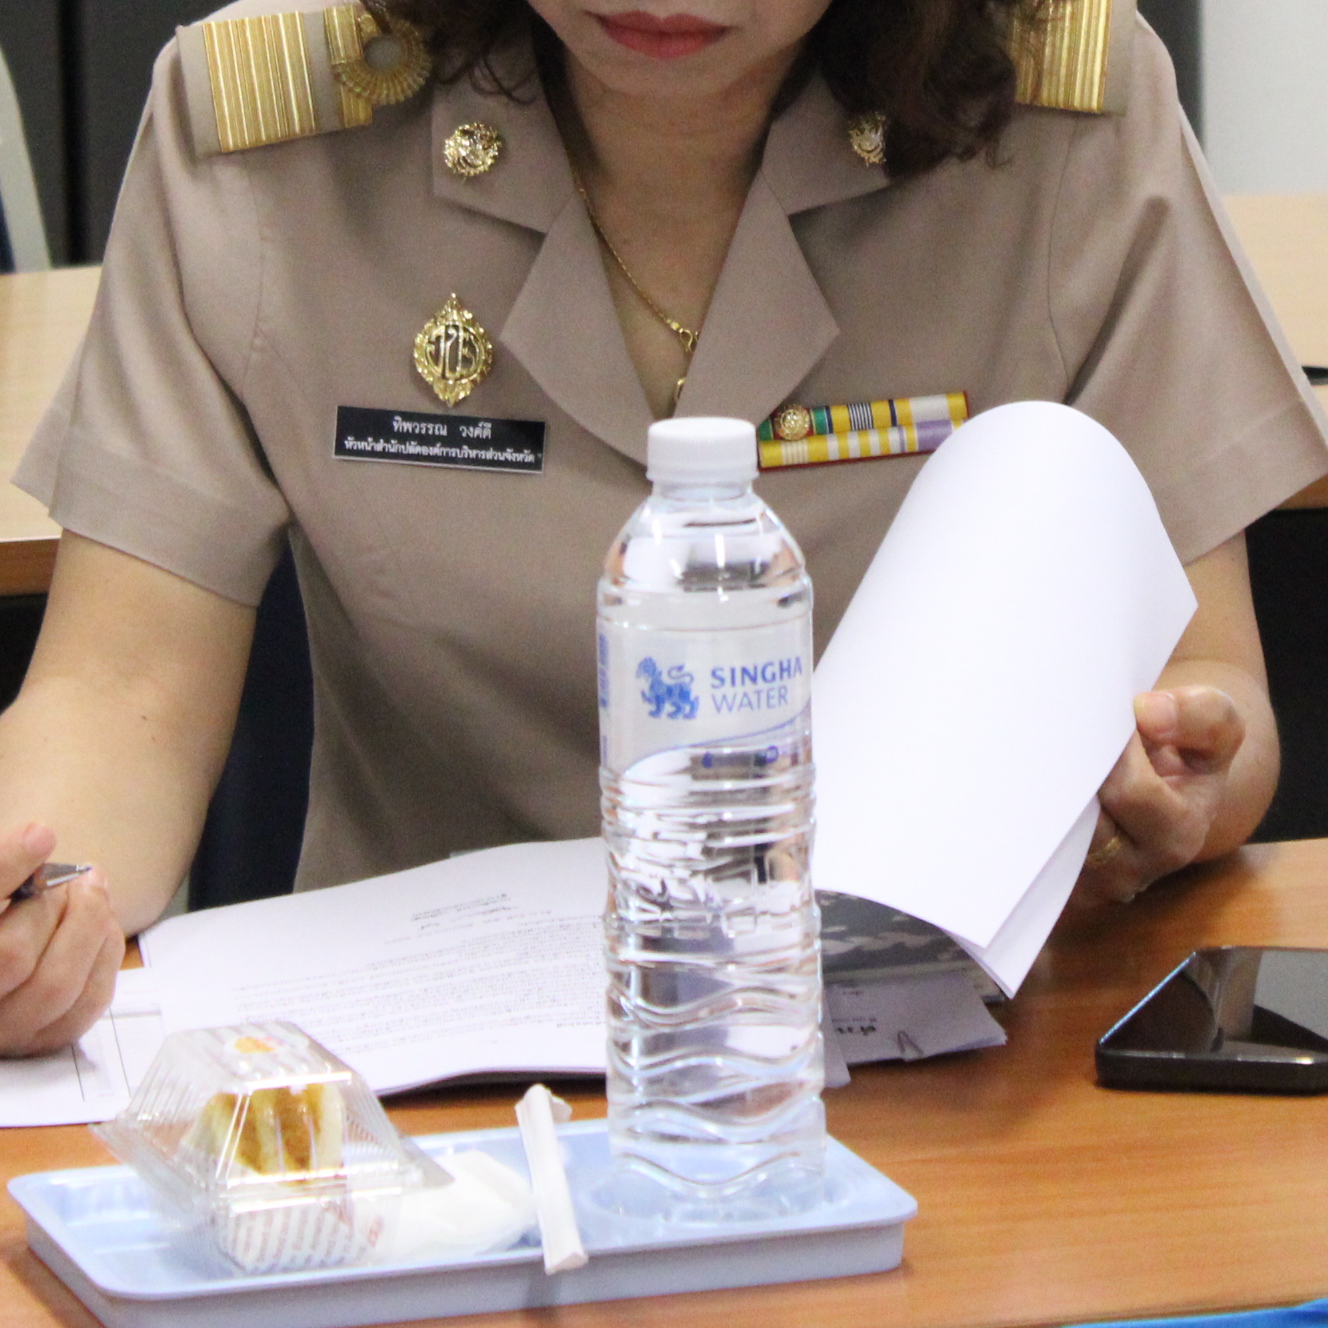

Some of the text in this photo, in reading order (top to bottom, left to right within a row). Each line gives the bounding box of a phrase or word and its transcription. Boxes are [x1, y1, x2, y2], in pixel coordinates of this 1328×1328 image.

[392, 416, 448, 436] ทิพวรรณ
[711, 656, 802, 689] SINGHA
[711, 685, 788, 714] WATER
